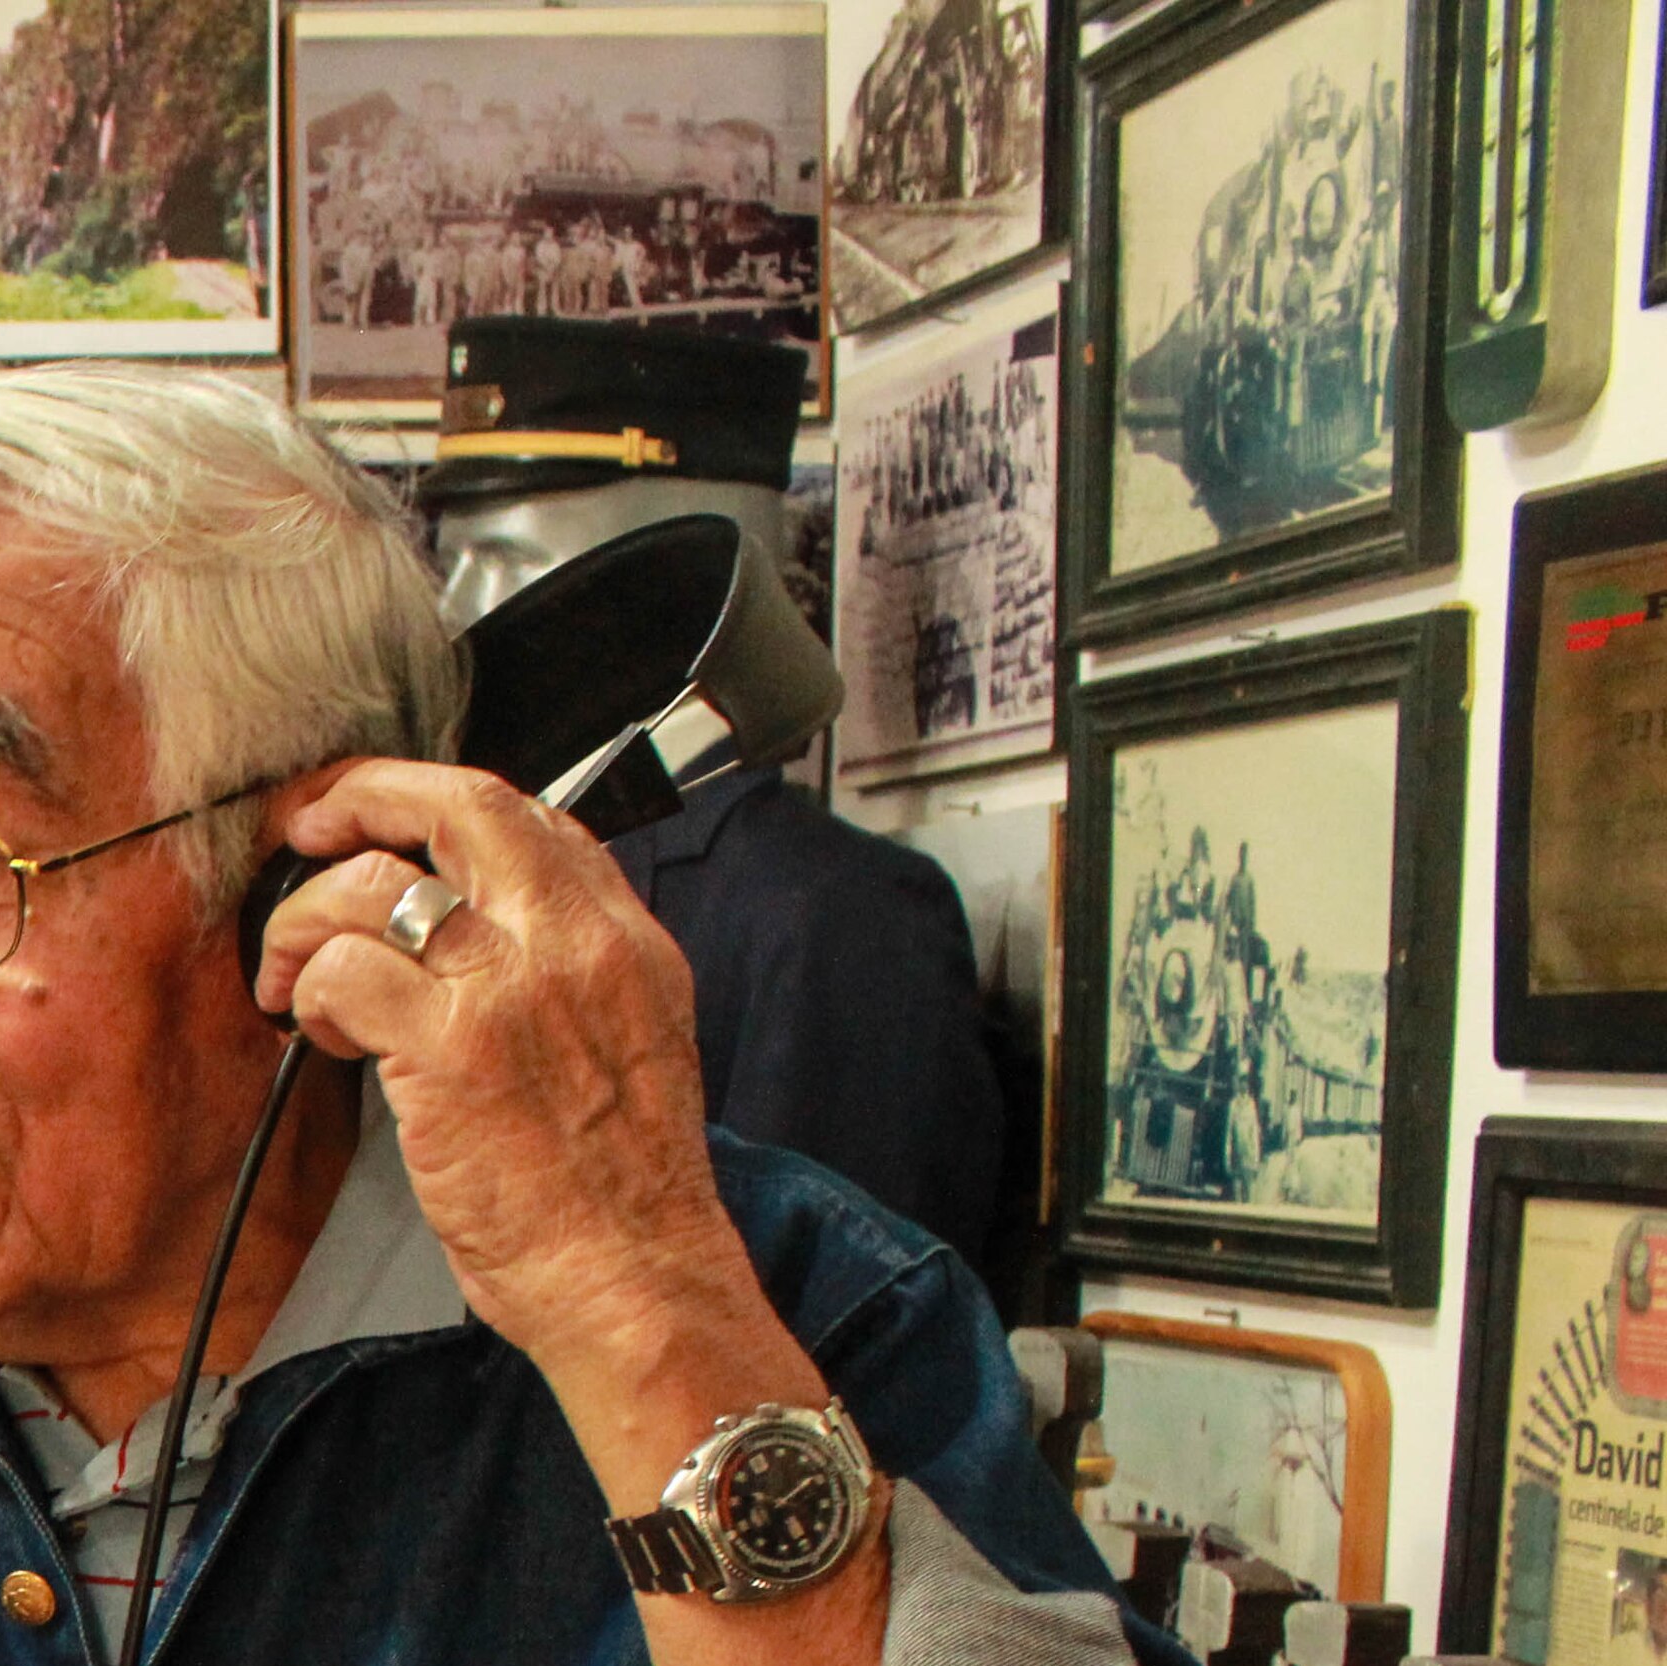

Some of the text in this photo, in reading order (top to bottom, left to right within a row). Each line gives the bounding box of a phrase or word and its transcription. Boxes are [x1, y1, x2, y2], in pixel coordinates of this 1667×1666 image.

[1570, 1417, 1666, 1490] David
[1569, 1498, 1666, 1539] centinela de
